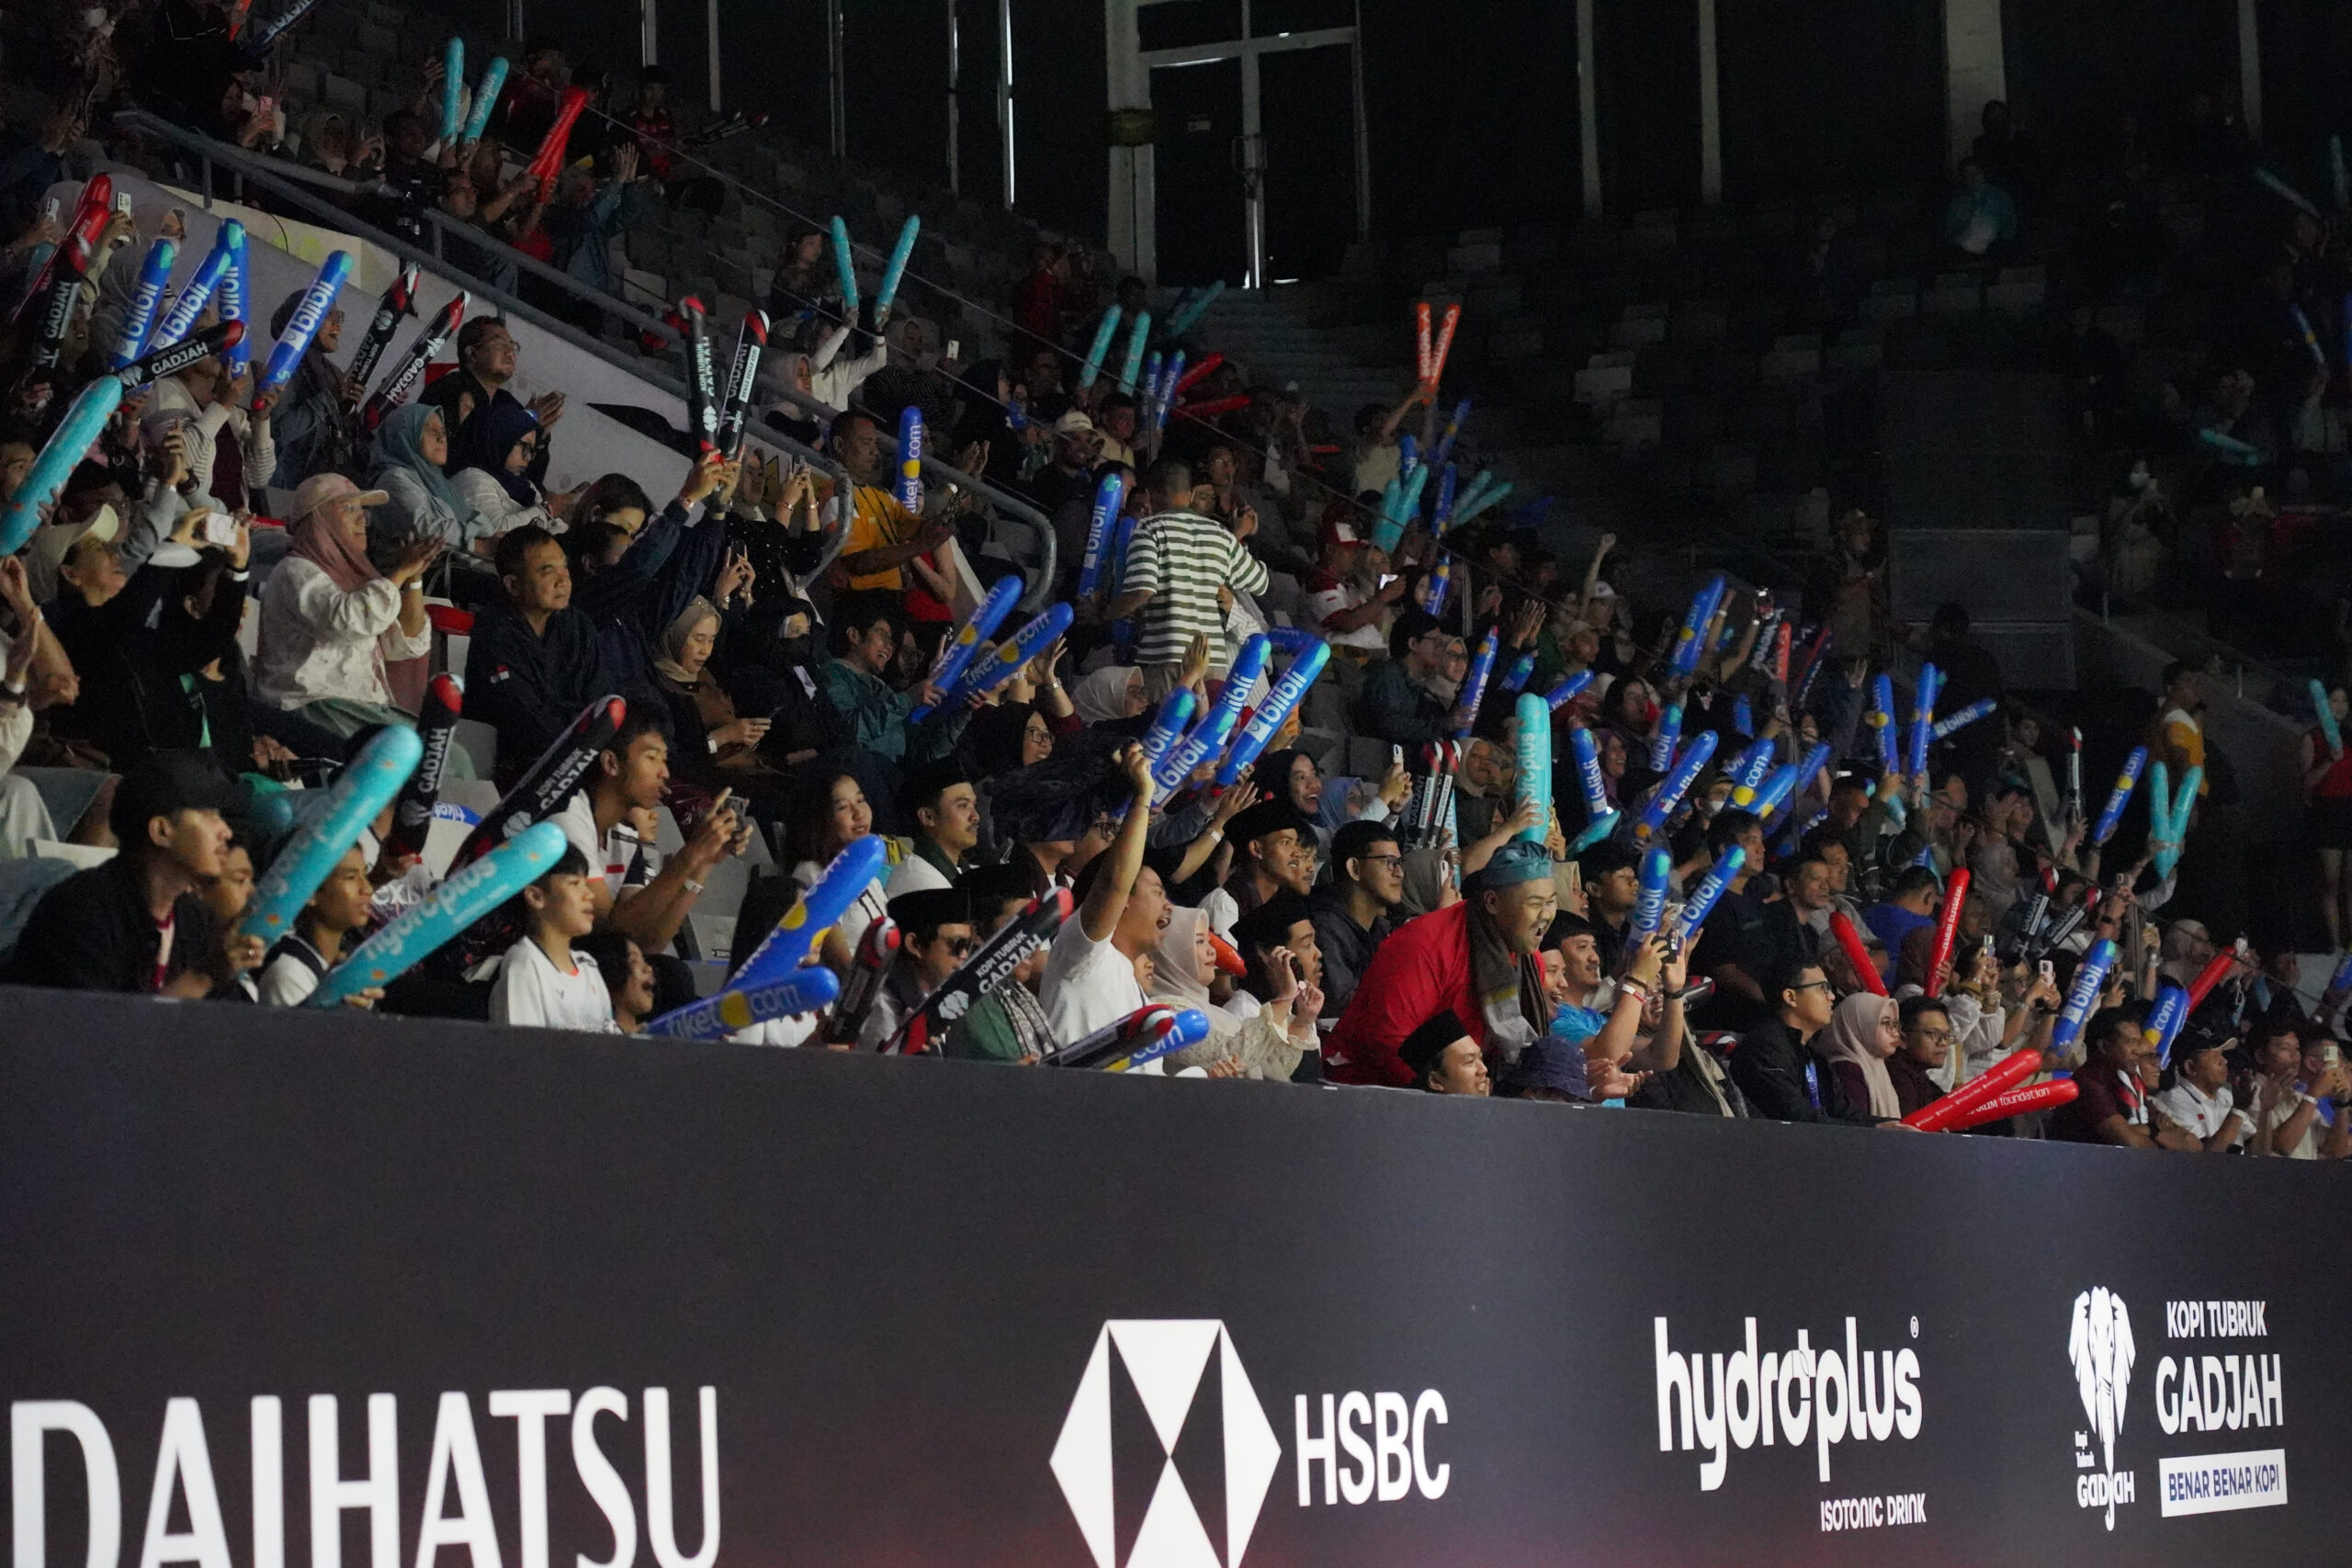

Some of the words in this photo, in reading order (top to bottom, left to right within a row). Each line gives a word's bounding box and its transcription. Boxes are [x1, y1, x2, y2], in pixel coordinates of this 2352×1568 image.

[47, 280, 72, 338] GADJAH
[164, 281, 211, 336] blibli
[294, 279, 335, 333] blibli
[151, 341, 209, 375] GADJAH
[386, 357, 424, 402] GADJAH
[908, 423, 921, 458] com
[1087, 505, 1106, 550] blibli
[1016, 611, 1051, 644] com
[1257, 671, 1307, 723] blibli
[418, 727, 448, 793] GADJAH
[539, 748, 600, 811] GADJAH
[1159, 734, 1209, 786] blibli
[1584, 755, 1605, 800] blibli
[1745, 754, 1770, 788] com
[535, 776, 557, 798] KOPI
[1682, 871, 1724, 920] blibli
[975, 957, 996, 978] KOPI
[994, 930, 1028, 960] TUBRUK
[978, 933, 1044, 995] GADJAH
[750, 985, 801, 1012] com
[2072, 964, 2104, 1008] blibli
[1999, 1086, 2050, 1107] foundation
[2166, 1301, 2205, 1338] KOPI
[2207, 1301, 2267, 1337] TUBRUK
[1655, 1316, 1923, 1491] hydroplus
[2155, 1354, 2284, 1435] GADJAH
[1295, 1389, 1450, 1506] HSBC
[11, 1385, 720, 1568] DAIHATSU
[2168, 1473, 2211, 1502] BENAR
[2213, 1469, 2254, 1498] BENAR
[2256, 1463, 2280, 1493] KOPI
[1820, 1496, 1883, 1532] ISOTONIC
[1886, 1493, 1928, 1526] DRINK
